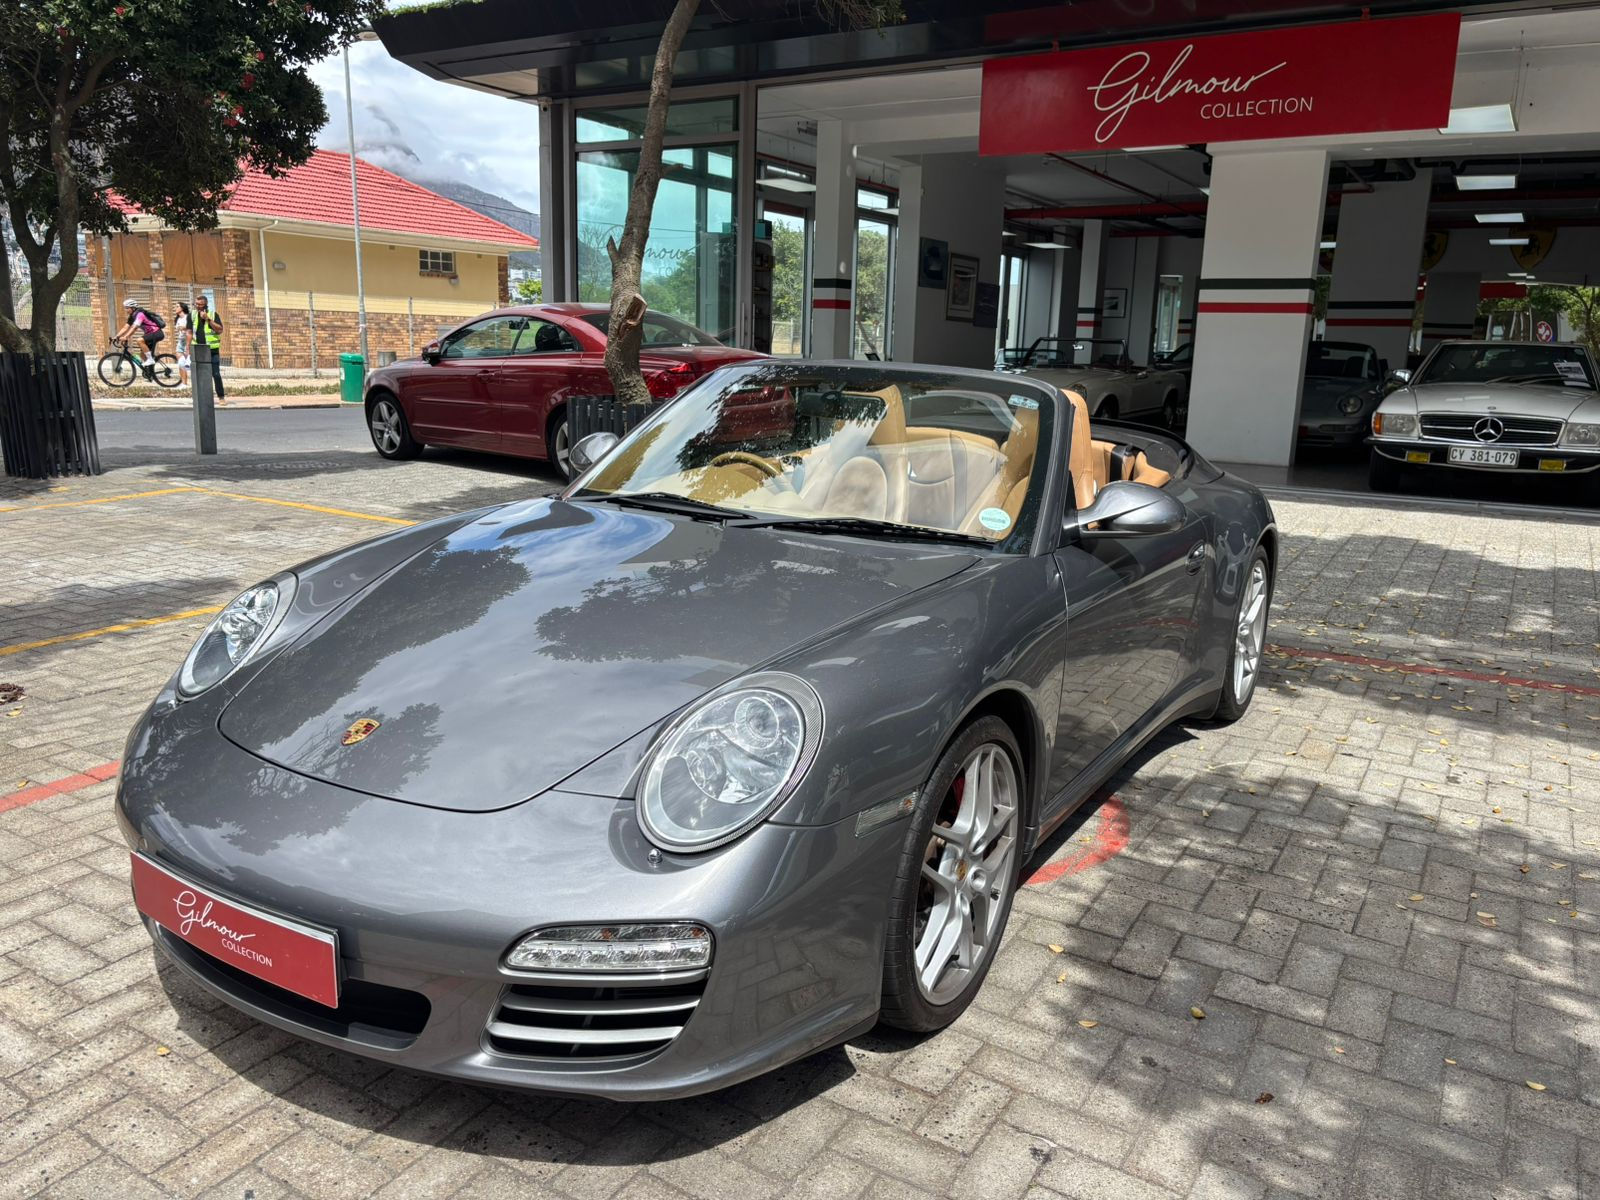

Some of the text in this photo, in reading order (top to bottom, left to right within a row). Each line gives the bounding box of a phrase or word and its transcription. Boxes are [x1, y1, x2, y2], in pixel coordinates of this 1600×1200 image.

[1087, 44, 1287, 143] Gilmour
[1200, 96, 1313, 120] COLLECTION
[1451, 449, 1465, 460] CY
[173, 890, 256, 942] Gilmour
[221, 938, 273, 967] COLLECTION
